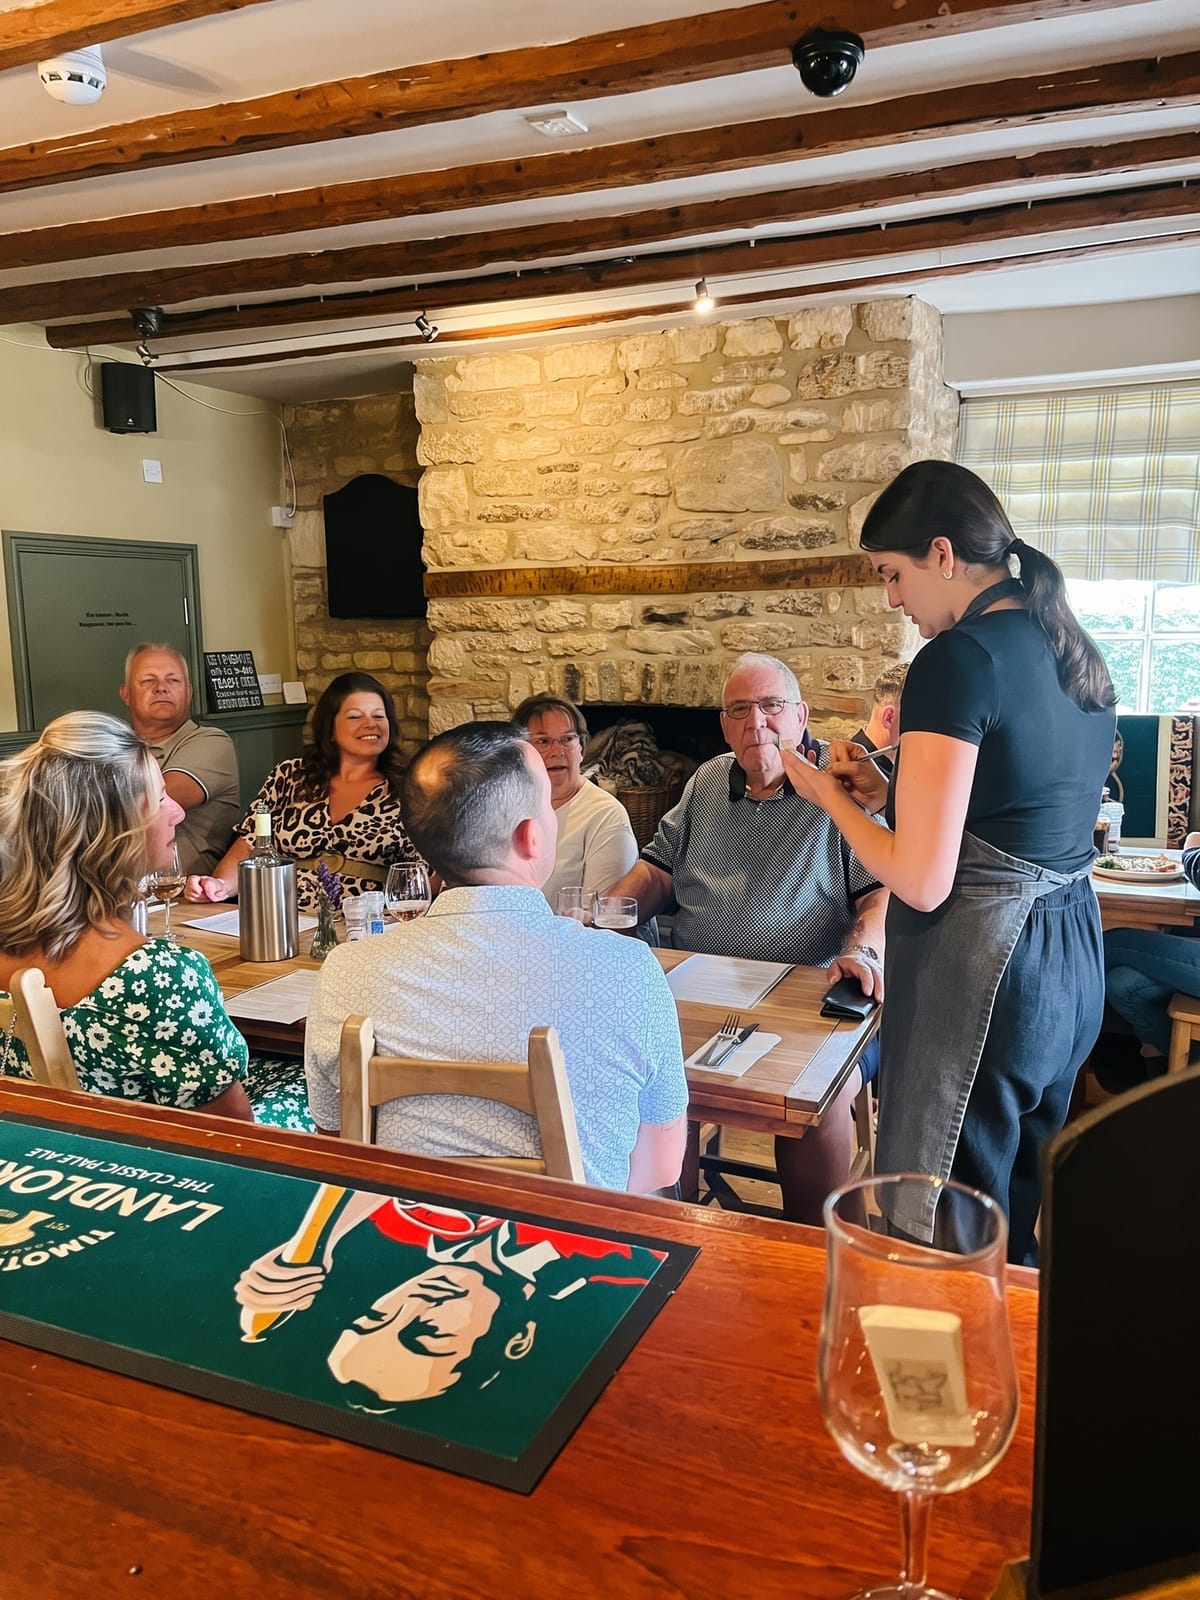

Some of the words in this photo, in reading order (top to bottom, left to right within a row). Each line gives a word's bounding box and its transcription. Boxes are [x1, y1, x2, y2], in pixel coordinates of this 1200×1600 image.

[25, 1147, 61, 1160] ALE
[59, 1153, 104, 1169] PALE
[100, 1163, 176, 1184] CLASSIC
[174, 1177, 215, 1193] THE
[0, 1159, 224, 1231] LANDLOR
[0, 1229, 116, 1272] TIMOT
